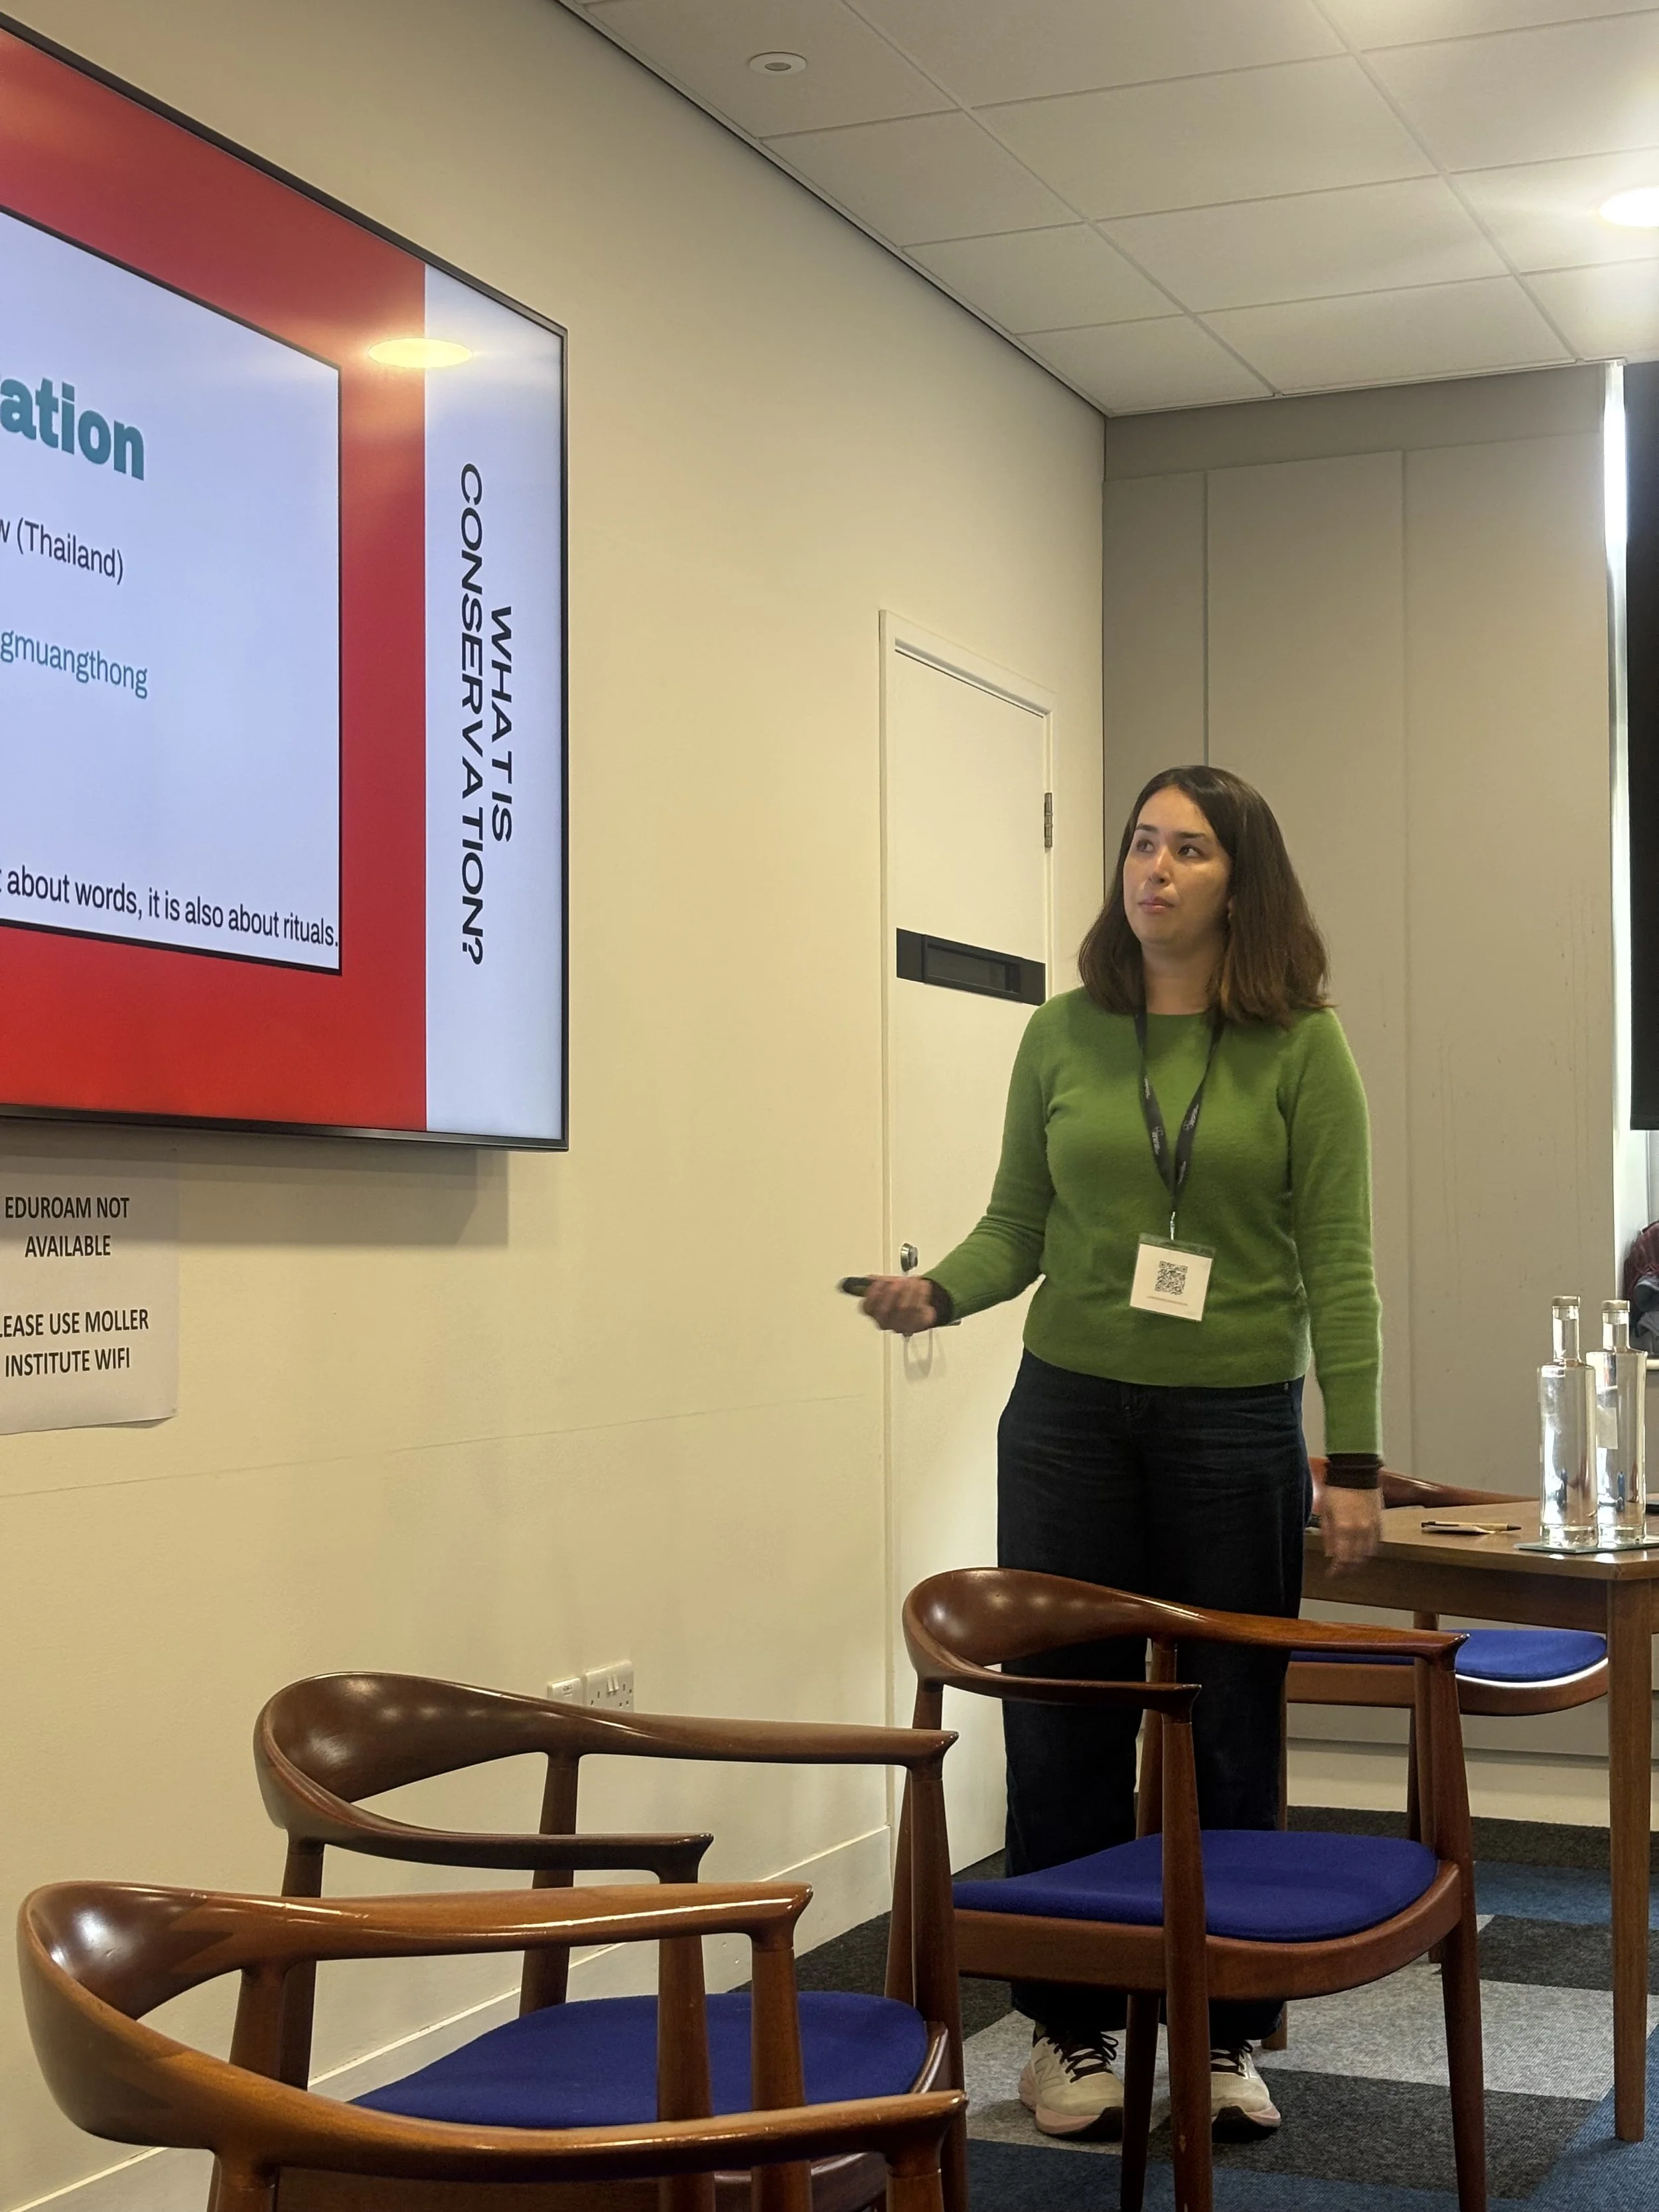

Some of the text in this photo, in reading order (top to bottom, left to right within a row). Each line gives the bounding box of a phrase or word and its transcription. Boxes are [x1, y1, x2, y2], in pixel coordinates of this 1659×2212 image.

[0, 378, 145, 481] ation
[17, 516, 124, 586] (Thailand)
[0, 629, 148, 700] gmuangthong
[461, 463, 484, 966] CONSERVATION?
[490, 605, 512, 843] WHAT IS
[7, 864, 70, 905] about
[75, 881, 143, 921] words,
[149, 886, 161, 919] it
[165, 889, 180, 922] is
[184, 895, 224, 929] also
[228, 903, 279, 939] about
[283, 911, 339, 948] rituals.
[5, 1196, 130, 1219] EDUROAM NOT
[24, 1234, 111, 1258] AVAILABLE
[49, 1312, 80, 1335] USE
[85, 1309, 149, 1333] MOLLER
[5, 1347, 130, 1378] INSTITUTE WIFI
